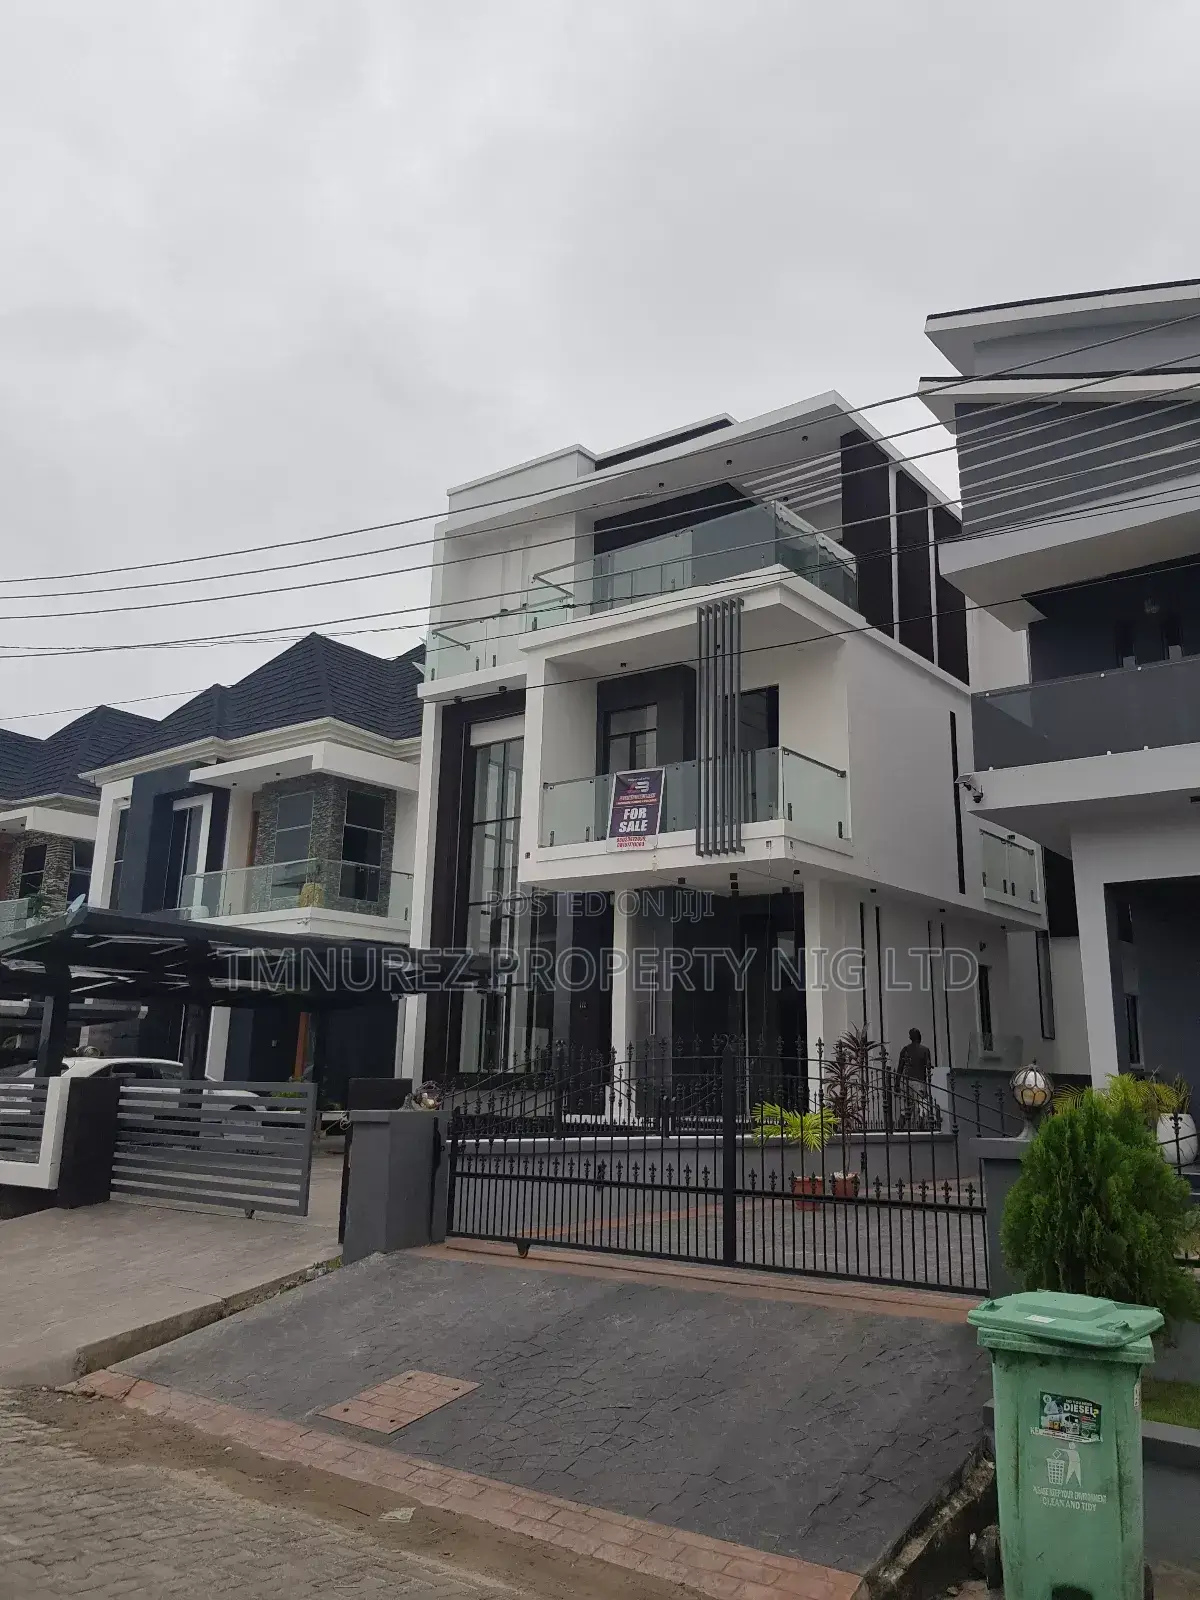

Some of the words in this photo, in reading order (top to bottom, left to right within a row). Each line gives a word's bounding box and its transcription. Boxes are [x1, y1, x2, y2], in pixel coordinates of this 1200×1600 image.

[623, 807, 647, 820] FOR
[618, 820, 648, 833] SALE
[1042, 1496, 1065, 1507] CLEAN
[1065, 1499, 1080, 1510] AND
[1081, 1502, 1097, 1512] TIDY
